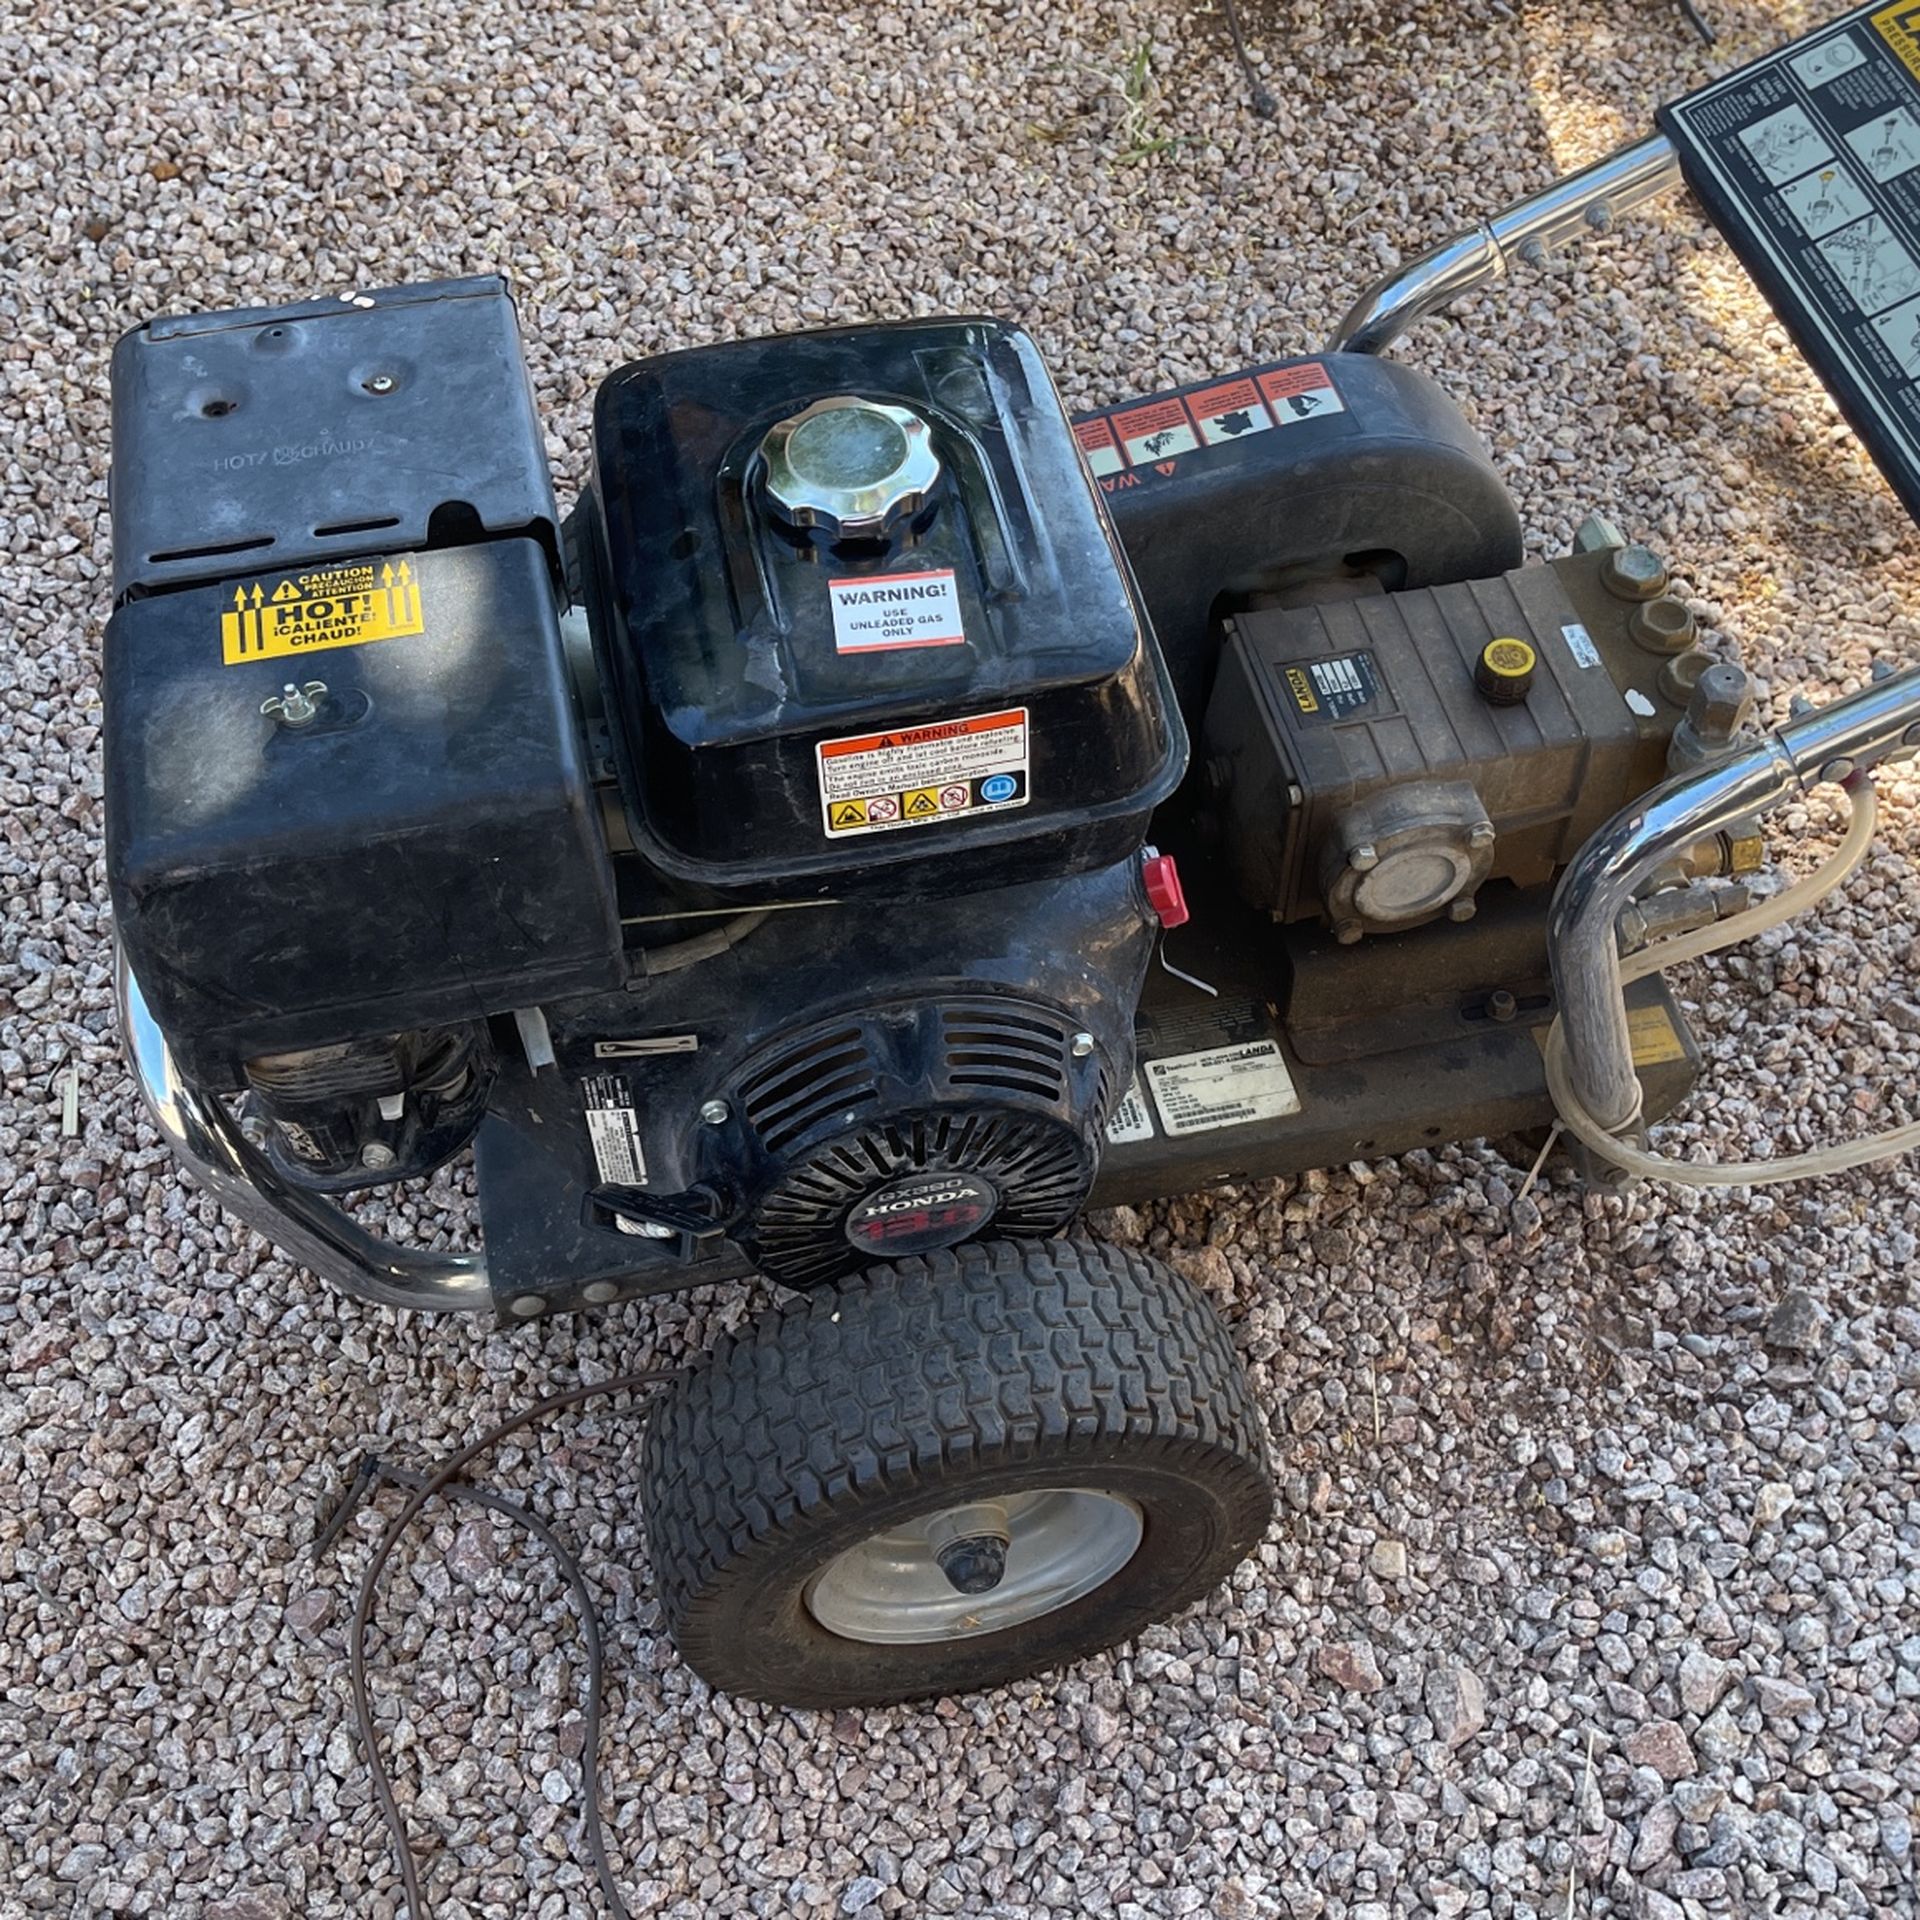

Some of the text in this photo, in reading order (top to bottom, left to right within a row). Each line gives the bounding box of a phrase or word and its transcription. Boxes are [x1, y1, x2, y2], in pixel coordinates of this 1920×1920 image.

[1783, 184, 1797, 197] 2
[1876, 313, 1891, 327] 4
[299, 565, 373, 585] CAUTION
[312, 582, 373, 598] ATTENTION
[838, 584, 947, 606] WARNING!
[276, 594, 372, 625] HOT!
[883, 608, 908, 618] USE
[850, 614, 944, 630] UNLEADED GAS
[290, 626, 362, 647] CHAUD!
[882, 627, 913, 637] ONLY
[900, 723, 969, 743] WARNING
[865, 1188, 980, 1217] HONDA
